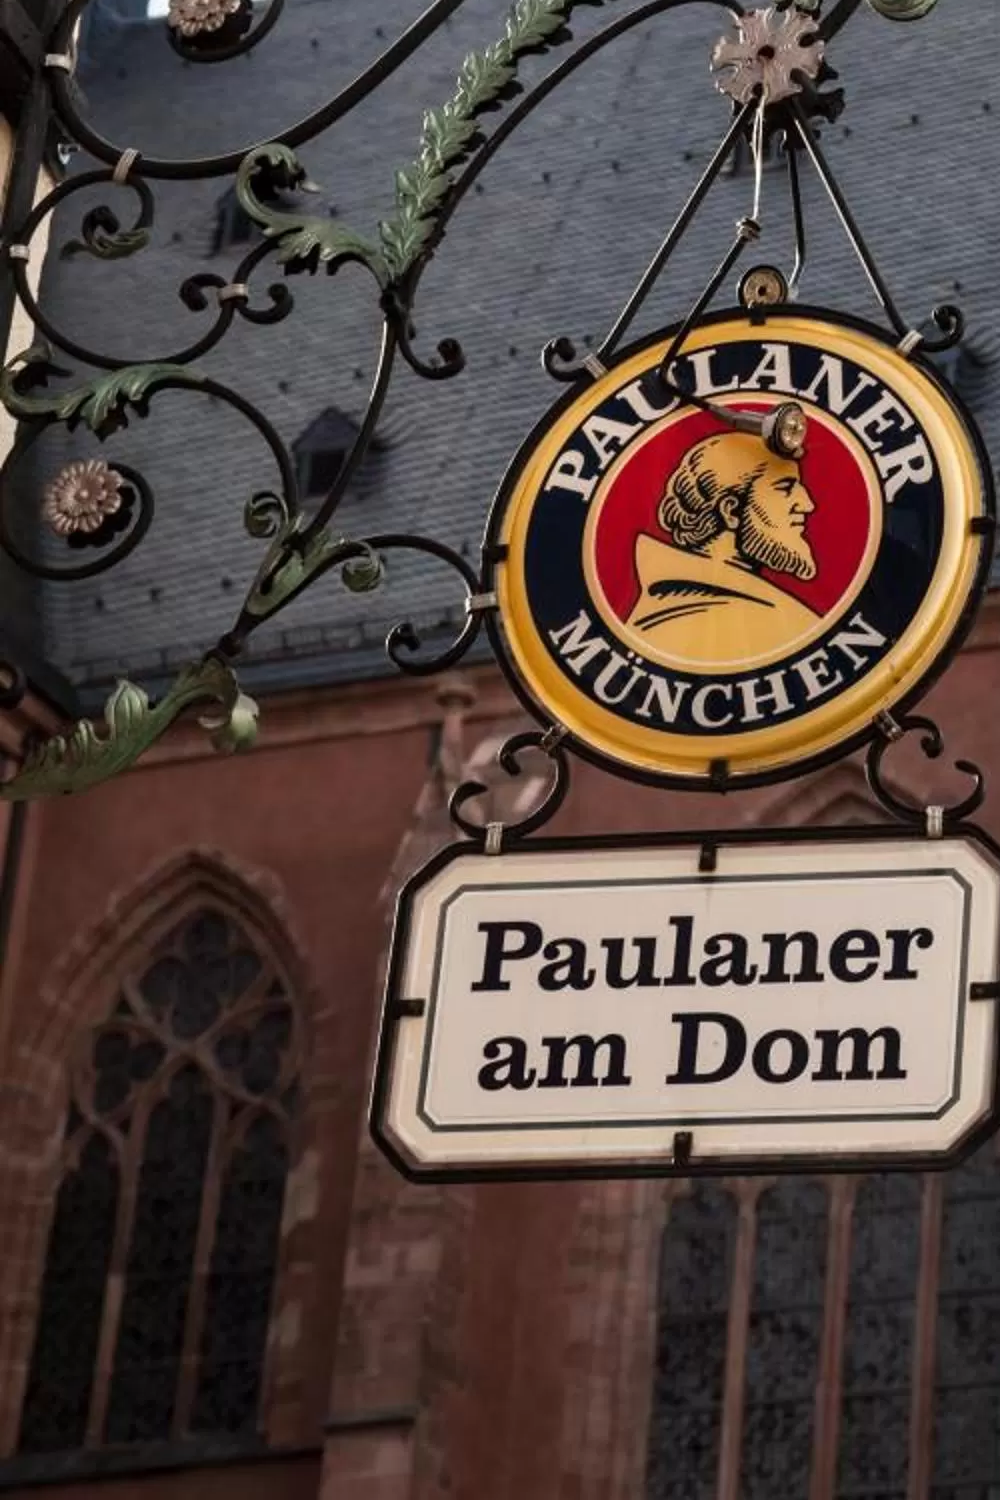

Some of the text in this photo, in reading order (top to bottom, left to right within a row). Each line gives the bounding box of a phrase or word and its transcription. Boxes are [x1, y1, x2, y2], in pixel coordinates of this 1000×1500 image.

[545, 343, 934, 503] PAULANER
[548, 609, 888, 728] MÜNCHEN
[471, 915, 934, 992] Paulaner
[477, 1011, 908, 1091] am Dom
